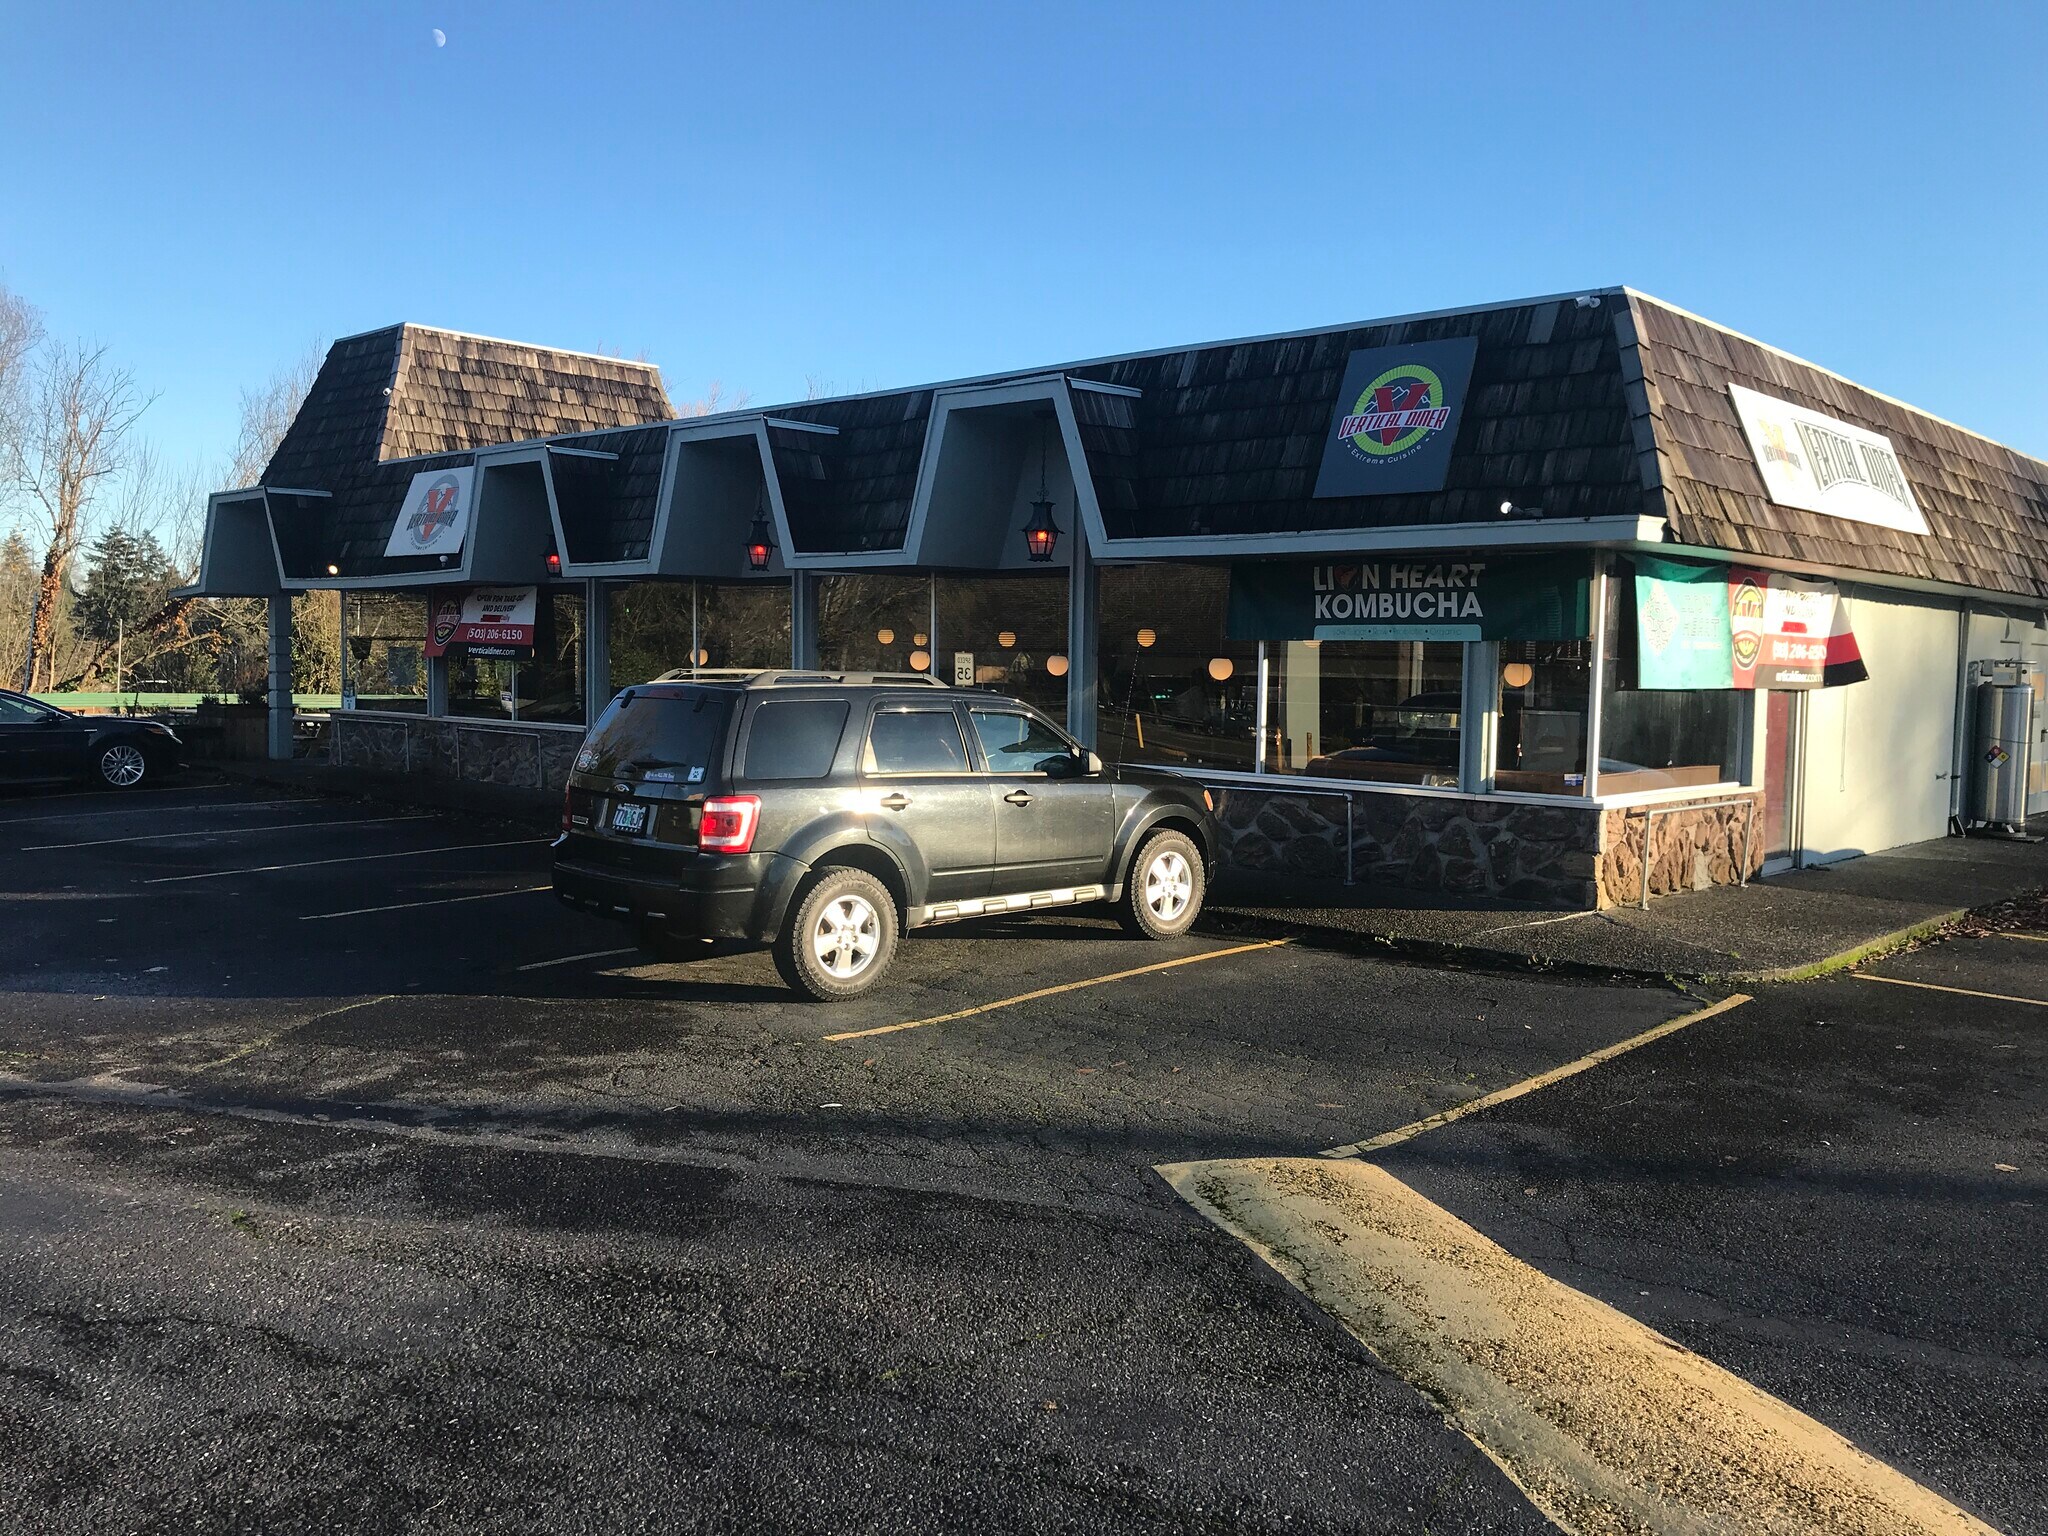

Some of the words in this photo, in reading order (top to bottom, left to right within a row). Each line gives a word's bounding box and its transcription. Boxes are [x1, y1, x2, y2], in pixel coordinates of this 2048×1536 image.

[1338, 411, 1401, 438] VERTICAL
[1404, 407, 1449, 430] DINER
[1350, 447, 1385, 465] Extreme
[1387, 444, 1422, 465] Cuisine
[1794, 421, 1867, 491] VERTICAL
[1859, 444, 1912, 512] DINER
[1390, 563, 1486, 589] HEART
[477, 594, 493, 602] OPEN
[492, 594, 502, 602] FOR
[482, 604, 493, 612] AND
[494, 604, 516, 612] DELIVERY
[1314, 591, 1484, 619] KOMBUCHA
[467, 627, 486, 641] (503)
[487, 629, 523, 640] 206-6150
[468, 646, 515, 656] verticaldiner.com
